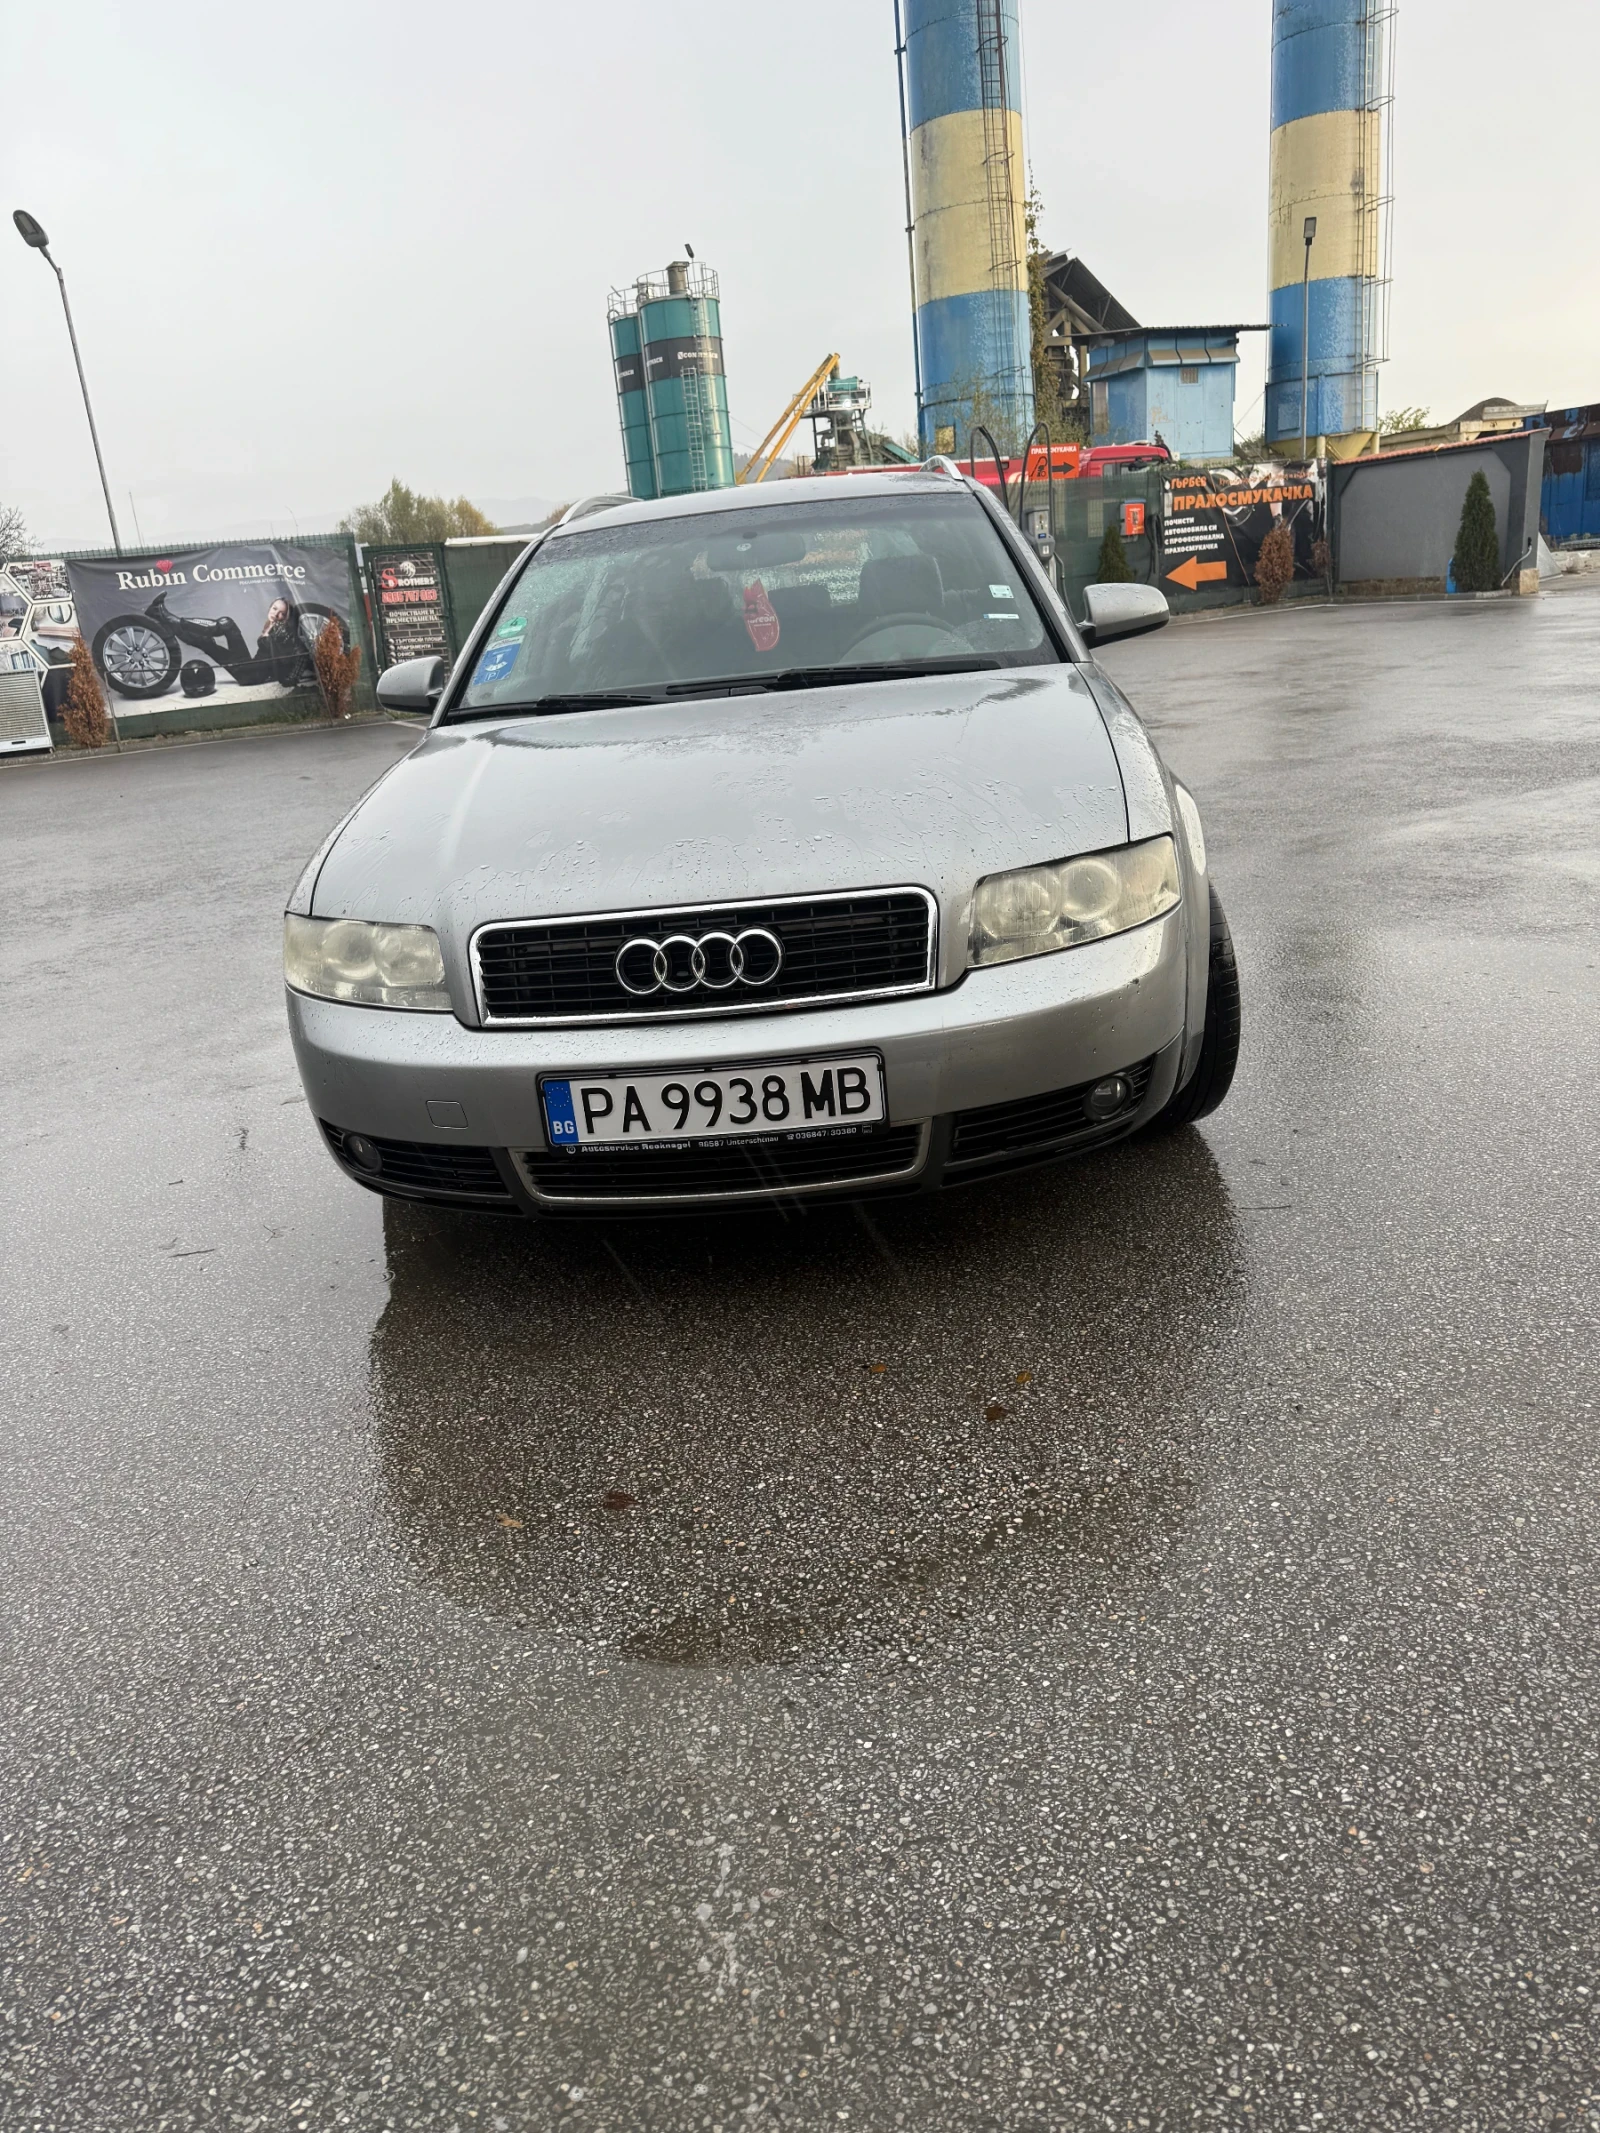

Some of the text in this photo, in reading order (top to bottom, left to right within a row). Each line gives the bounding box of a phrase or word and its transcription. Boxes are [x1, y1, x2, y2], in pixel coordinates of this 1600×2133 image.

[1173, 484, 1314, 511] ПРАХОСМУКАЧКА
[1164, 517, 1195, 527] ПОЧИСТИ
[1164, 525, 1208, 536] АВТОМОБИЛА
[1170, 533, 1225, 545] ПРОФЕСИОНАЛНА
[1164, 543, 1219, 555] ПРАХОСМУКАЧКА
[116, 563, 306, 590] Rubin Commerce
[580, 1066, 872, 1134] PA 9938 MB
[553, 1120, 575, 1136] BG
